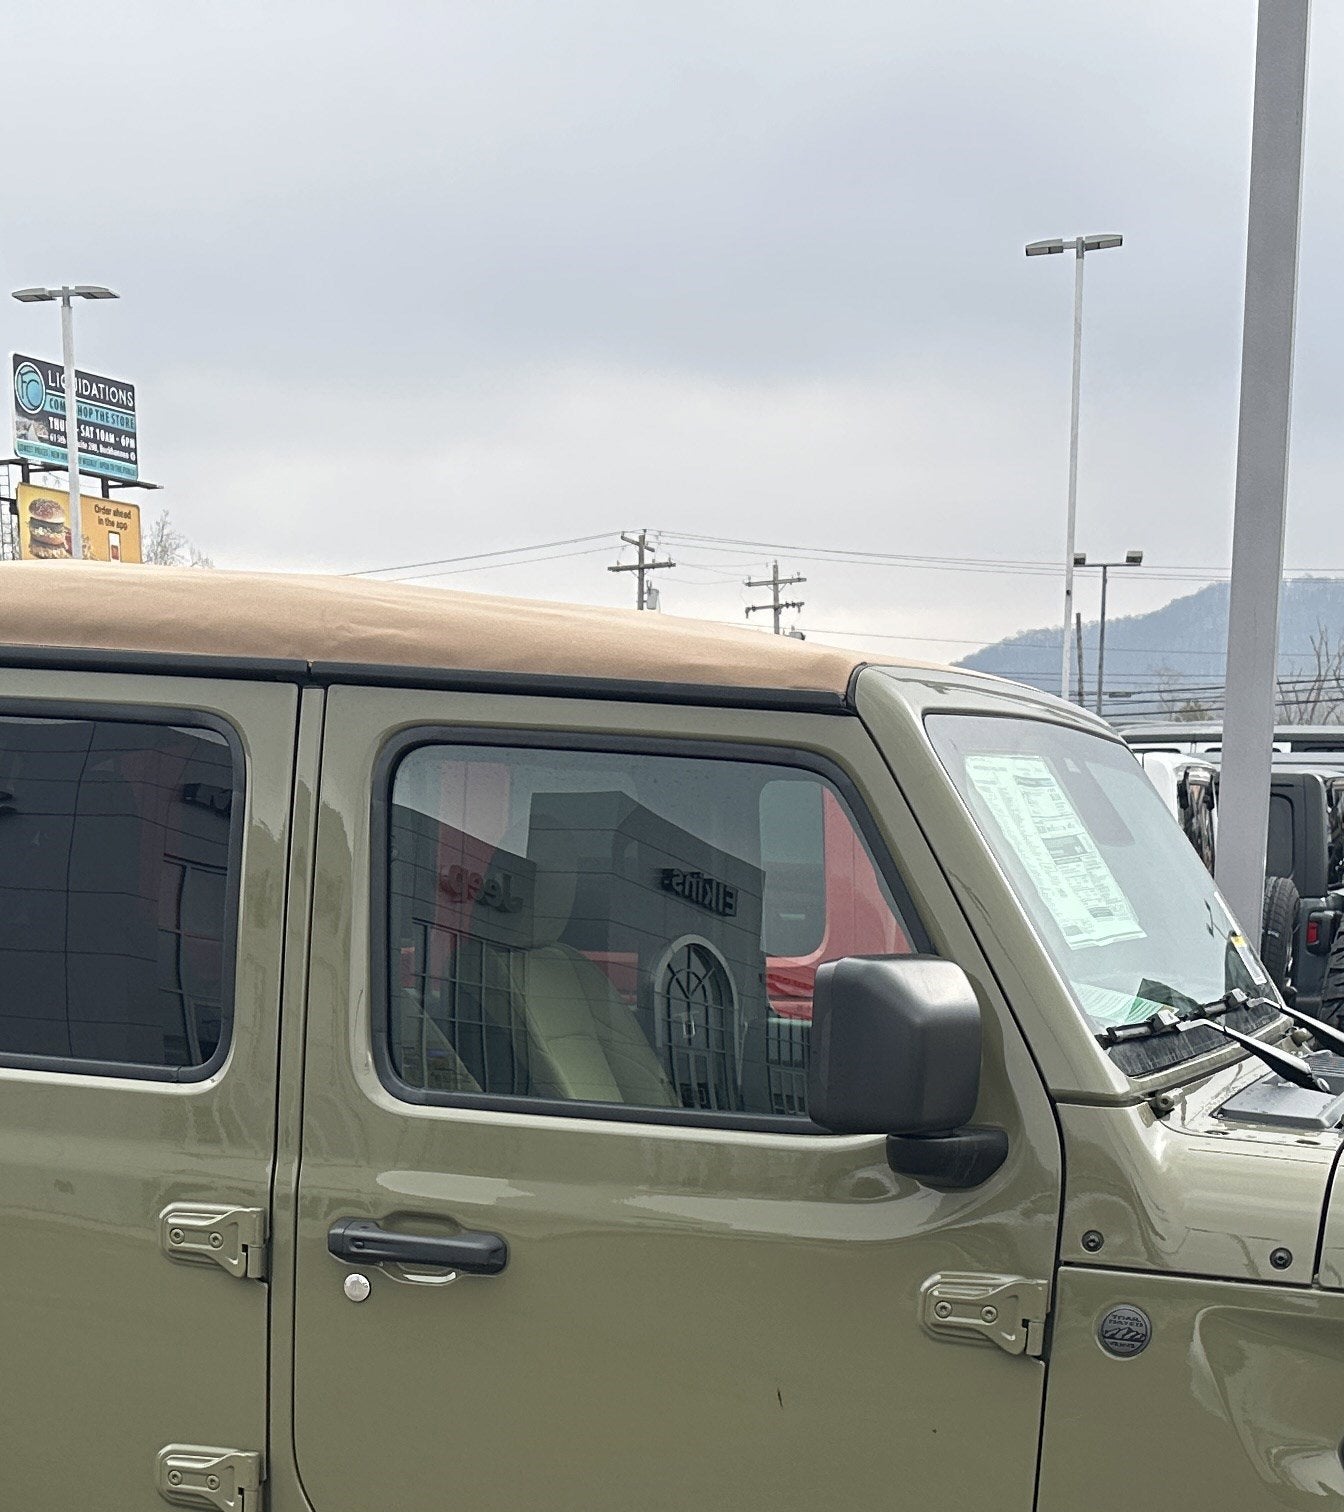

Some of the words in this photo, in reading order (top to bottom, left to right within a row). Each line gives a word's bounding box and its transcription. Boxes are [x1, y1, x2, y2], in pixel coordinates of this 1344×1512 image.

[49, 397, 66, 412] COM
[77, 406, 93, 419] HOP
[95, 409, 110, 422] THE
[111, 412, 134, 428] STORE
[80, 424, 94, 439] SAT
[96, 428, 115, 444] 10AM
[120, 434, 135, 449] 6PM
[94, 504, 111, 515] Order
[113, 508, 131, 519] ahead
[105, 517, 115, 527] the
